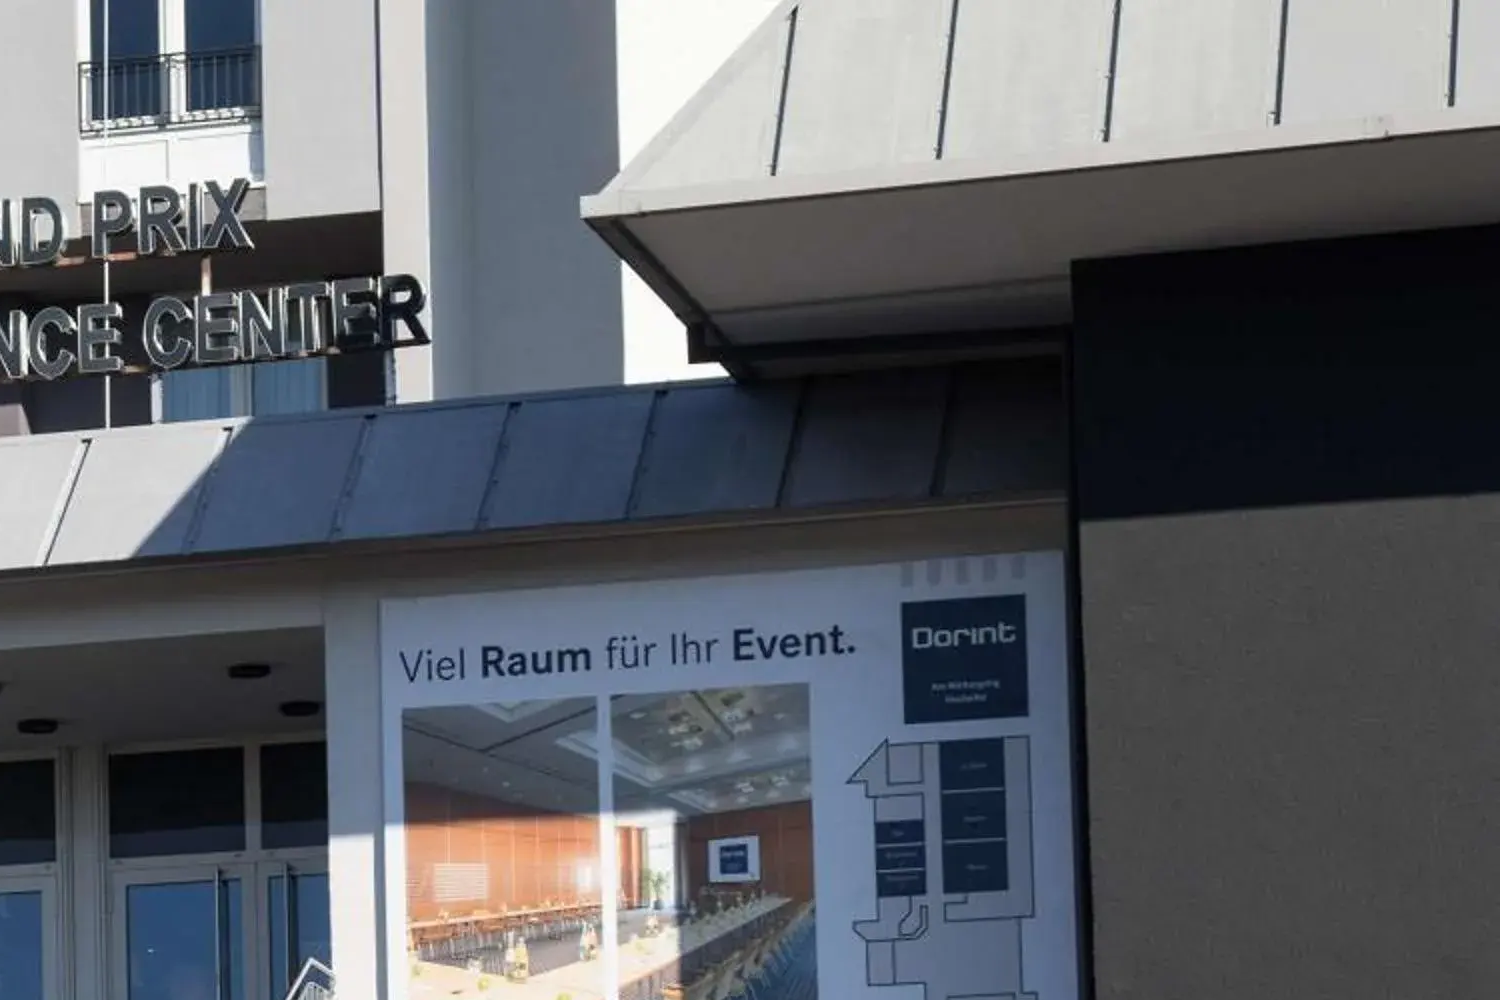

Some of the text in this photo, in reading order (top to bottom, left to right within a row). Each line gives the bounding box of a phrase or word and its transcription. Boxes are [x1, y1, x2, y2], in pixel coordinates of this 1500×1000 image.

[92, 177, 255, 260] PRIX
[142, 273, 432, 370] CENTER
[399, 624, 857, 683] Viel Raum für Ihr Event.
[911, 620, 1017, 649] Dorint
